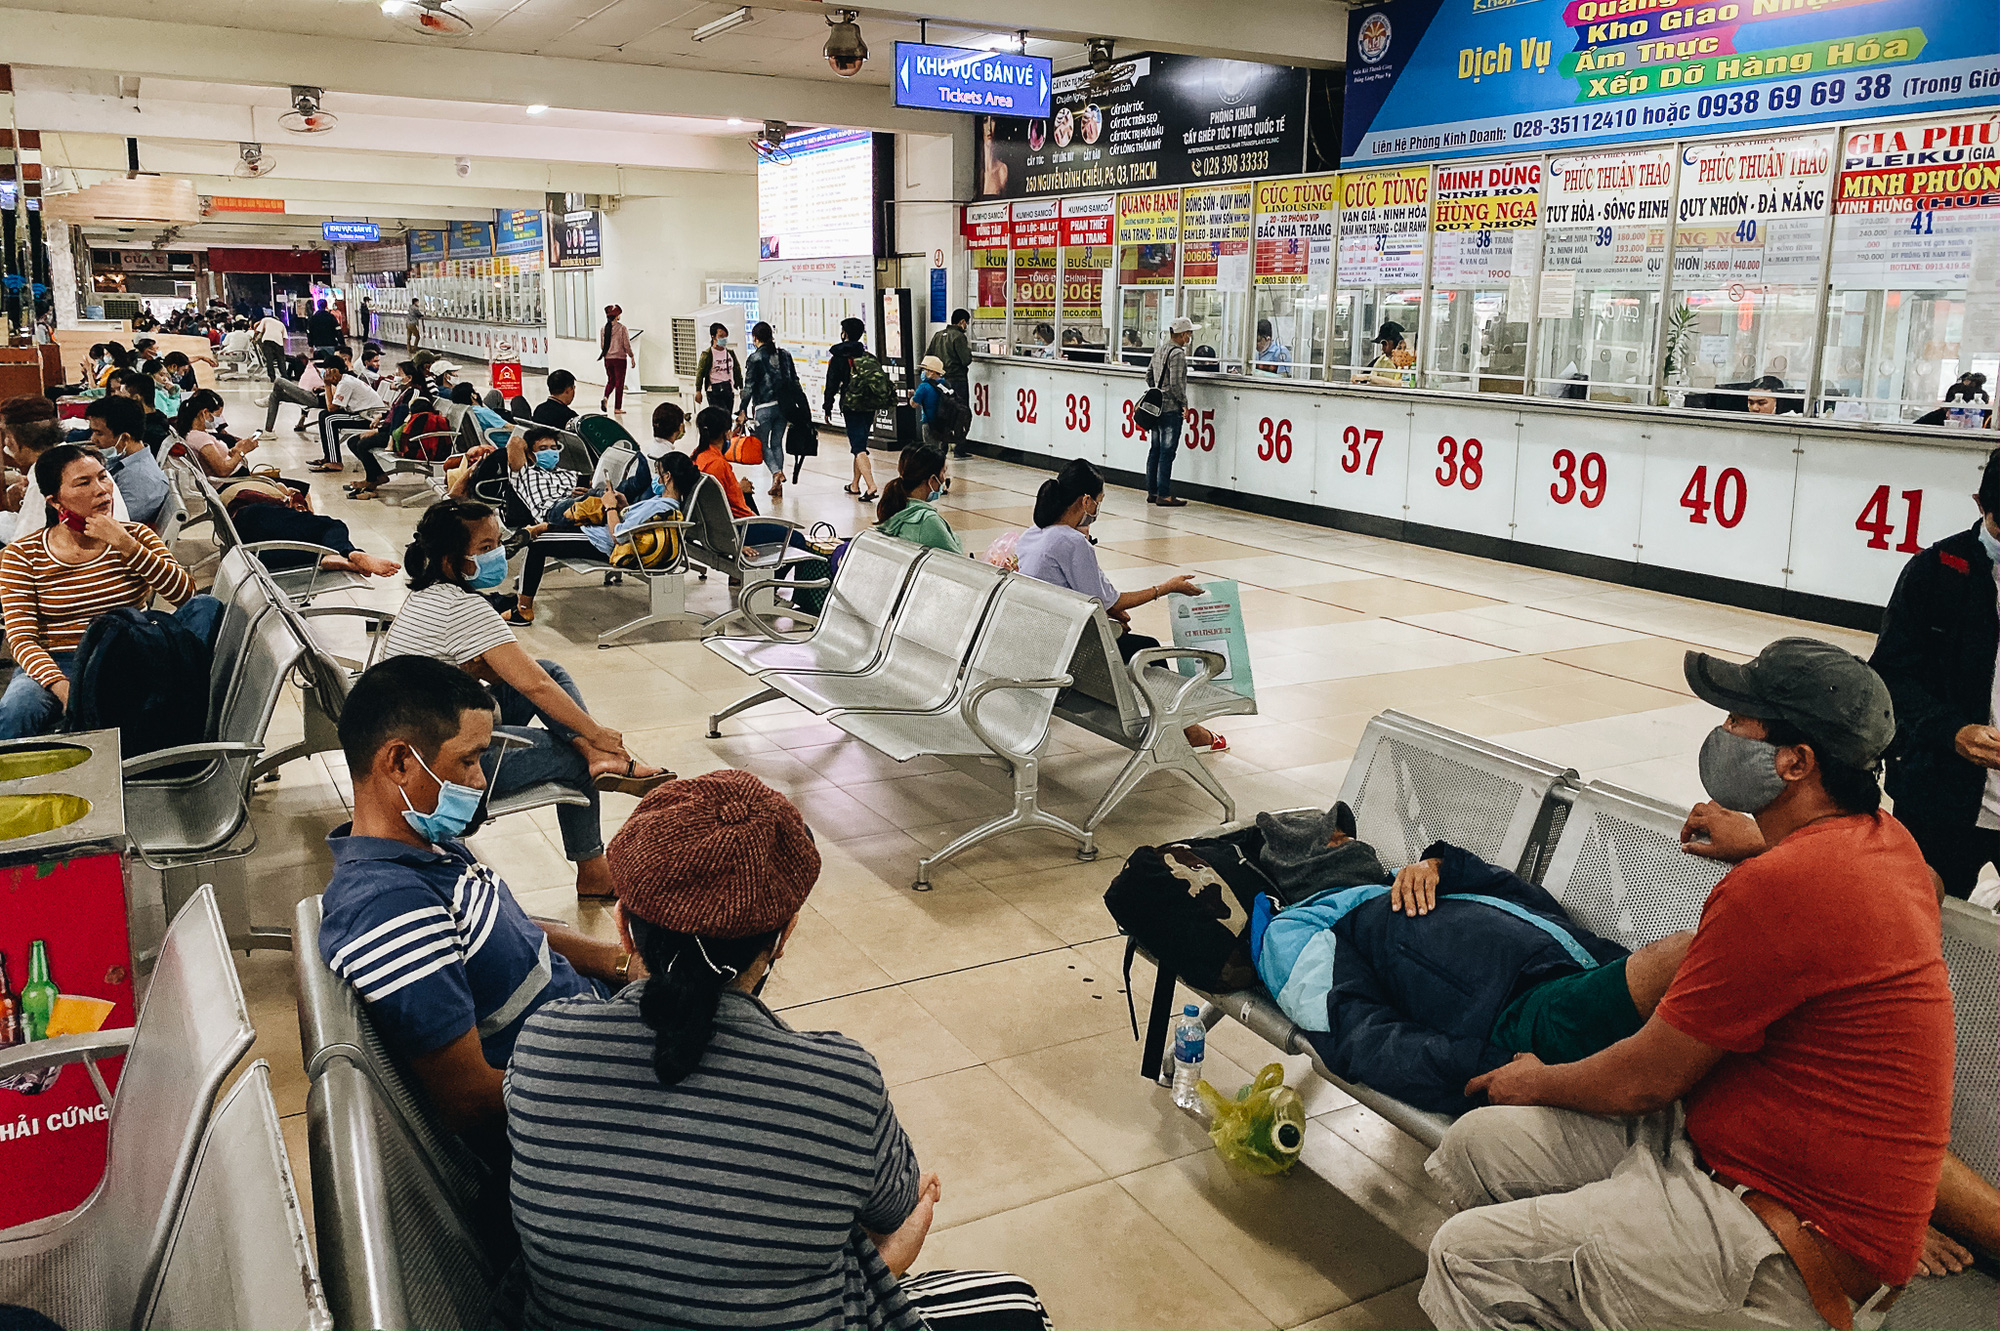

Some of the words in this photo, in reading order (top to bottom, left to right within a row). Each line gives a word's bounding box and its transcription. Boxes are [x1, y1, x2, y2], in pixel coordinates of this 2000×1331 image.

[1587, 20, 1649, 43] Kho
[1659, 5, 1739, 31] Giao
[1458, 43, 1511, 83] Dịch
[1520, 37, 1552, 73] Vụ
[1574, 45, 1626, 72] Ẩm
[1637, 36, 1719, 61] Thực
[916, 56, 948, 77] KHU
[983, 61, 1014, 84] BÁN
[1014, 64, 1034, 86] VÉ
[1587, 69, 1648, 98] Xếp
[1658, 64, 1704, 88] Dỡ
[1715, 51, 1812, 81] Hàng
[1826, 38, 1908, 67] Hóa
[938, 86, 983, 106] Tickets
[984, 91, 1014, 108] Area
[1210, 110, 1234, 124] PHÒNG
[1235, 105, 1257, 120] KHÁM
[1372, 140, 1392, 154] Liên
[1394, 138, 1407, 153] Hệ
[1409, 133, 1440, 151] Phòng
[1443, 131, 1466, 147] Kinh
[1469, 126, 1507, 143] Doanh:
[1513, 108, 1634, 139] 028-35112410
[1642, 103, 1690, 126] hoặc
[1697, 89, 1759, 119] 0938
[1768, 85, 1801, 112] 69
[1810, 79, 1846, 107] 69
[1855, 73, 1892, 101] 38
[1902, 74, 1961, 99] (Trong
[1198, 125, 1216, 143] GHÉP
[1217, 123, 1232, 140] TÓC
[1232, 127, 1238, 138] Y
[1238, 123, 1253, 139] HỌC
[1254, 118, 1275, 135] QUỐC
[1275, 115, 1286, 132] TẾ
[1847, 131, 1908, 156] GIA
[1920, 114, 2000, 150] PHÚ
[1203, 155, 1221, 176] 028
[1222, 153, 1240, 175] 398
[1240, 150, 1270, 173] 33333
[1698, 151, 1735, 183] PHÚC
[1738, 146, 1785, 184] THUẬN
[1789, 139, 1829, 177] THẢO
[1845, 149, 1965, 170] PLEIKU
[1968, 146, 1996, 161] (GIA
[1130, 161, 1157, 181] TP.HCM
[1438, 169, 1483, 191] MINH
[1488, 161, 1541, 187] DŨNG
[1563, 163, 1594, 192] PHÚC
[1596, 160, 1636, 193] THUẬN
[1638, 154, 1671, 187] THẢO
[1260, 183, 1289, 205] CÚC
[1293, 179, 1333, 203] TÙNG
[1345, 175, 1377, 208] CÚC
[1382, 171, 1428, 206] TÙNG
[1438, 190, 1488, 200] NINH
[1494, 185, 1539, 197] HÒA
[1842, 173, 1908, 198] MINH
[1068, 205, 1088, 213] KUMHO
[1089, 203, 1108, 212] SAMCO
[1121, 194, 1152, 218] QUANG
[1203, 193, 1216, 211] SƠN
[1220, 195, 1233, 210] QUY
[1265, 203, 1327, 213] LIMOUSINE
[1436, 200, 1490, 222] HÙNG
[1495, 201, 1538, 220] NGA
[1547, 205, 1569, 223] TUY
[1570, 199, 1594, 222] HÒA
[1603, 197, 1636, 221] SÔNG
[1638, 200, 1669, 219] HINH
[1679, 197, 1707, 222] QUY
[1709, 191, 1748, 216] NHƠN
[1757, 187, 1777, 214] ĐÀ
[1781, 180, 1824, 212] NẴNG
[1070, 219, 1088, 231] PHAN
[1089, 216, 1107, 230] THIẾT
[1308, 213, 1320, 221] VIP
[1342, 210, 1361, 225] VẠN
[1383, 209, 1407, 220] NINH
[1408, 206, 1428, 219] HÒA
[1435, 222, 1474, 233] QUY
[1480, 219, 1537, 229] NHƠN
[1910, 211, 1933, 235] 41
[1070, 234, 1084, 244] NHA
[1084, 232, 1107, 243] TRANG
[1132, 228, 1151, 241] TRANG
[1257, 220, 1276, 239] BẮC
[1277, 225, 1296, 238] NHA
[1299, 222, 1331, 236] TRANG
[1354, 225, 1368, 235] NHA
[1368, 222, 1391, 234] TRANG
[1476, 229, 1491, 248] 38
[1595, 226, 1613, 247] 39
[1735, 219, 1757, 242] 40
[1287, 238, 1299, 254] 36
[1375, 234, 1388, 252] 37
[1616, 244, 1645, 252] 193.000
[1614, 255, 1643, 264] 222.000
[1703, 260, 1729, 270] 345.000
[1733, 260, 1760, 270] 440.000
[1065, 272, 1087, 282] CHÍNH
[1488, 269, 1511, 278] 1900
[974, 382, 991, 417] 31
[1016, 387, 1037, 424] 32
[1066, 393, 1092, 433] 33
[1184, 407, 1216, 452] 35
[1257, 416, 1293, 465] 36
[1341, 425, 1385, 476] 37
[1435, 435, 1484, 490] 38
[1550, 448, 1608, 508] 39
[1680, 464, 1749, 529] 40
[1854, 483, 1926, 555] 41
[0, 1113, 39, 1142] HẢI
[46, 1103, 109, 1131] CỨNG
